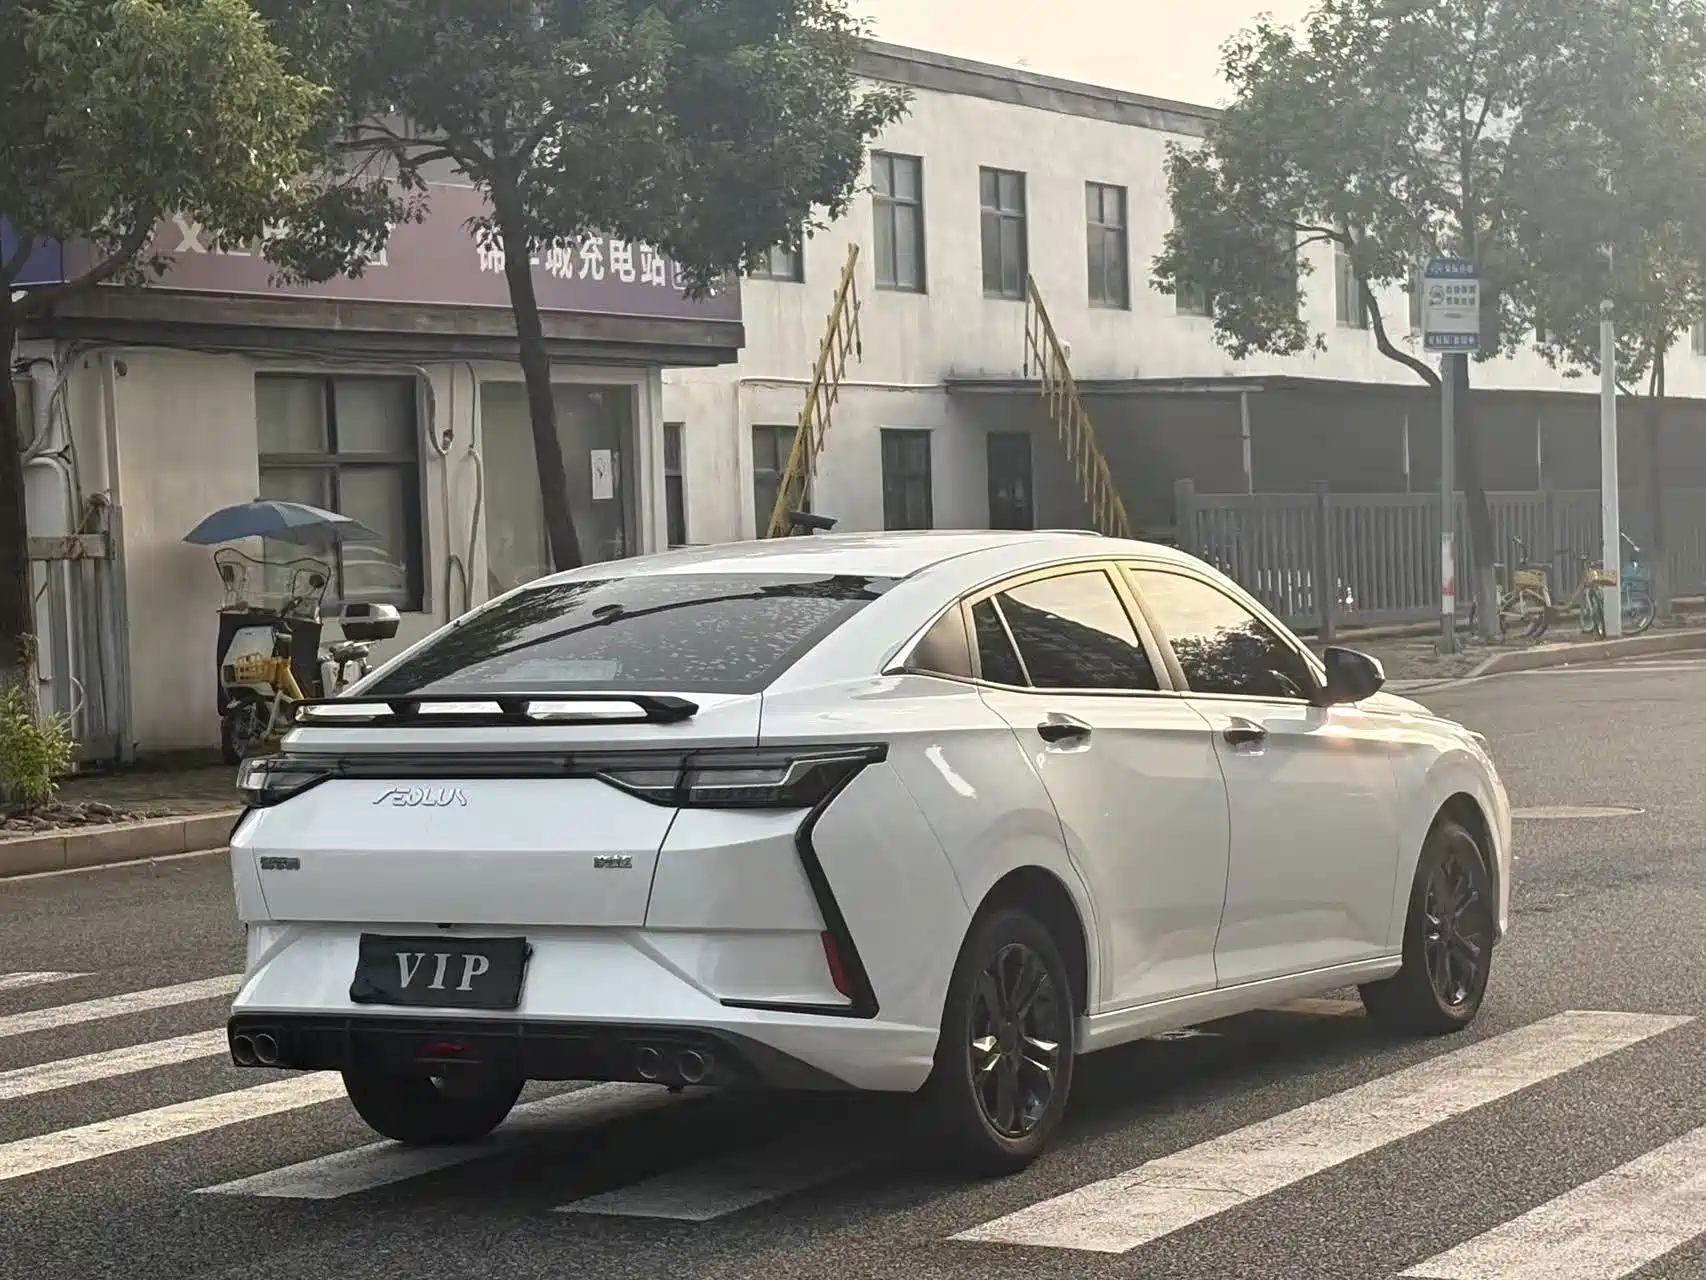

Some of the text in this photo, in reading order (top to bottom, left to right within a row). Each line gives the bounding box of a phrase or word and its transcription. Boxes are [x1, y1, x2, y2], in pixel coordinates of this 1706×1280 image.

[476, 226, 666, 288] 锦城充电站
[395, 952, 490, 991] VIP
